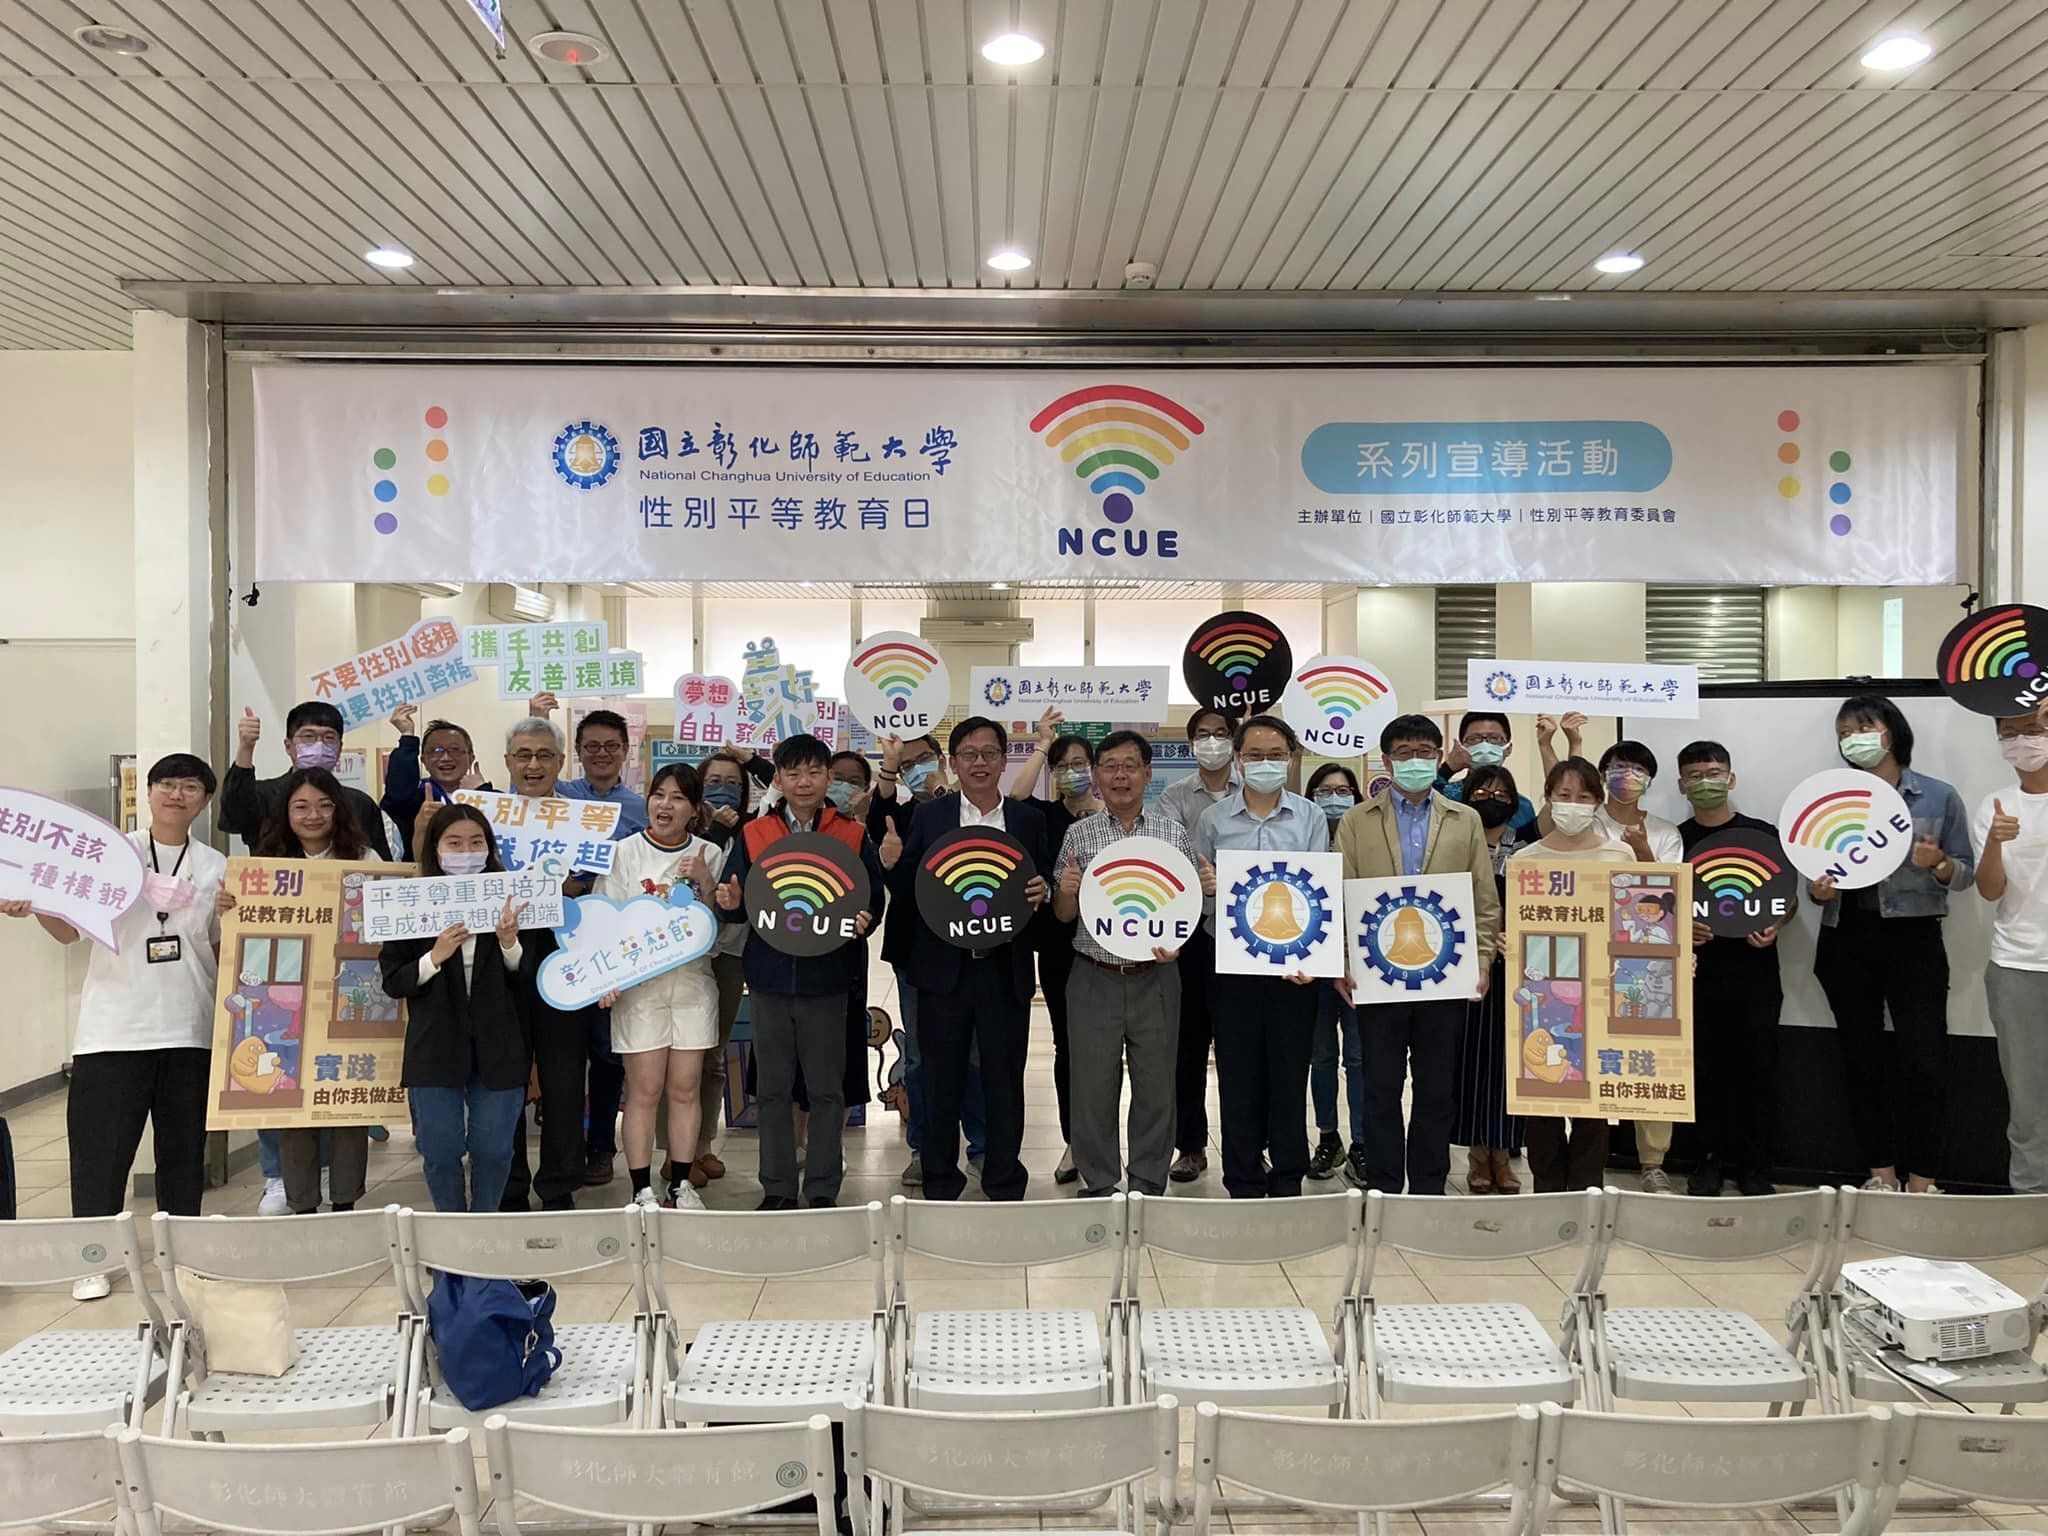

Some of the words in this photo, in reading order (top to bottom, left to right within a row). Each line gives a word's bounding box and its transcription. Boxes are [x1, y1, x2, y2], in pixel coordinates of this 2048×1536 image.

[638, 422, 958, 477] 國立彰化師範大學
[1356, 440, 1619, 479] 系列宣導活動
[639, 469, 696, 481] National
[700, 470, 771, 483] Changhua
[775, 471, 842, 483] University
[846, 472, 860, 481] of
[863, 472, 930, 482] Education
[640, 496, 930, 531] 性別平等教育日
[1297, 509, 1363, 524] 主辦單位
[1380, 509, 1512, 524] 國立彰化師範大學
[1530, 507, 1676, 523] 性別平等教育委員會
[1058, 528, 1178, 558] NCUE
[471, 628, 601, 660] 攜手共創
[310, 622, 460, 699] 不要性別歧視
[507, 660, 639, 693] 友善環境
[1018, 677, 1152, 701] 國立彰化師範大學
[1525, 673, 1680, 701] 國立彰化師範大學
[2015, 666, 2048, 707] NC
[1213, 688, 1271, 709] NCUE
[874, 713, 929, 729] NCUE
[1305, 729, 1365, 748] NCUE
[1826, 814, 1910, 884] NCUE
[0, 858, 128, 910] 一種樣貌
[238, 867, 304, 897] 性別
[371, 875, 557, 910] 平等尊重與培力
[1517, 870, 1575, 897] 性別
[238, 906, 333, 924] 從教育扎根
[1519, 905, 1605, 923] 從教育扎根
[1693, 898, 1786, 918] NCUE
[758, 910, 856, 939] NCUE
[949, 916, 1012, 937] NCUE
[1096, 917, 1188, 939] NCUE
[314, 1053, 377, 1082] 實踐
[1597, 1048, 1657, 1077] 實踐
[313, 1086, 405, 1105] 由你我做起
[1599, 1081, 1686, 1100] 由你我做起
